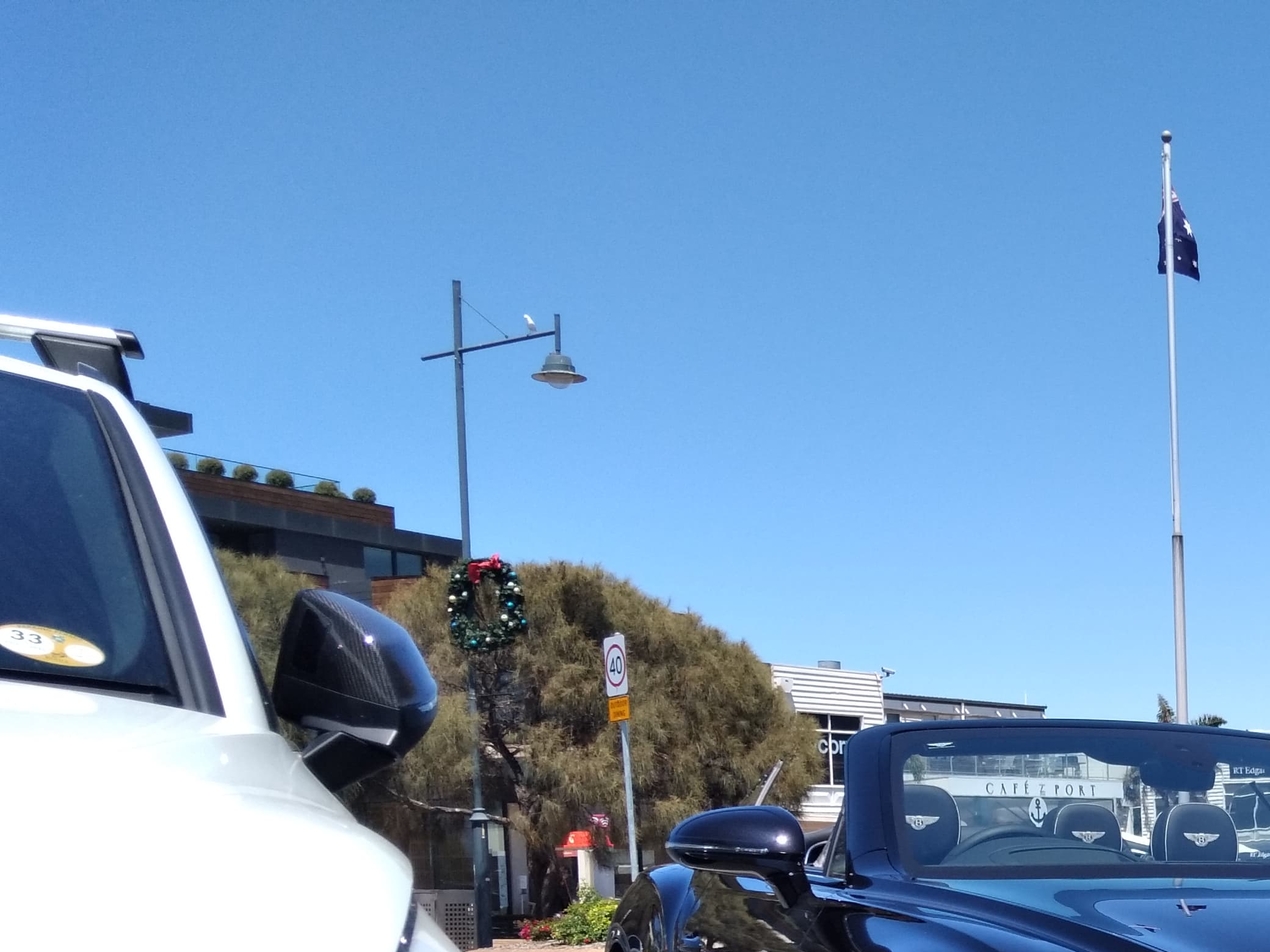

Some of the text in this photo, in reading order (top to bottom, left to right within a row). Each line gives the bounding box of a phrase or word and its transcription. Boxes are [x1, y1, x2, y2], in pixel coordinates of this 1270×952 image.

[11, 629, 42, 644] 33
[610, 656, 622, 675] 40
[985, 780, 1030, 795] CAFÉ
[1054, 784, 1097, 797] PORT
